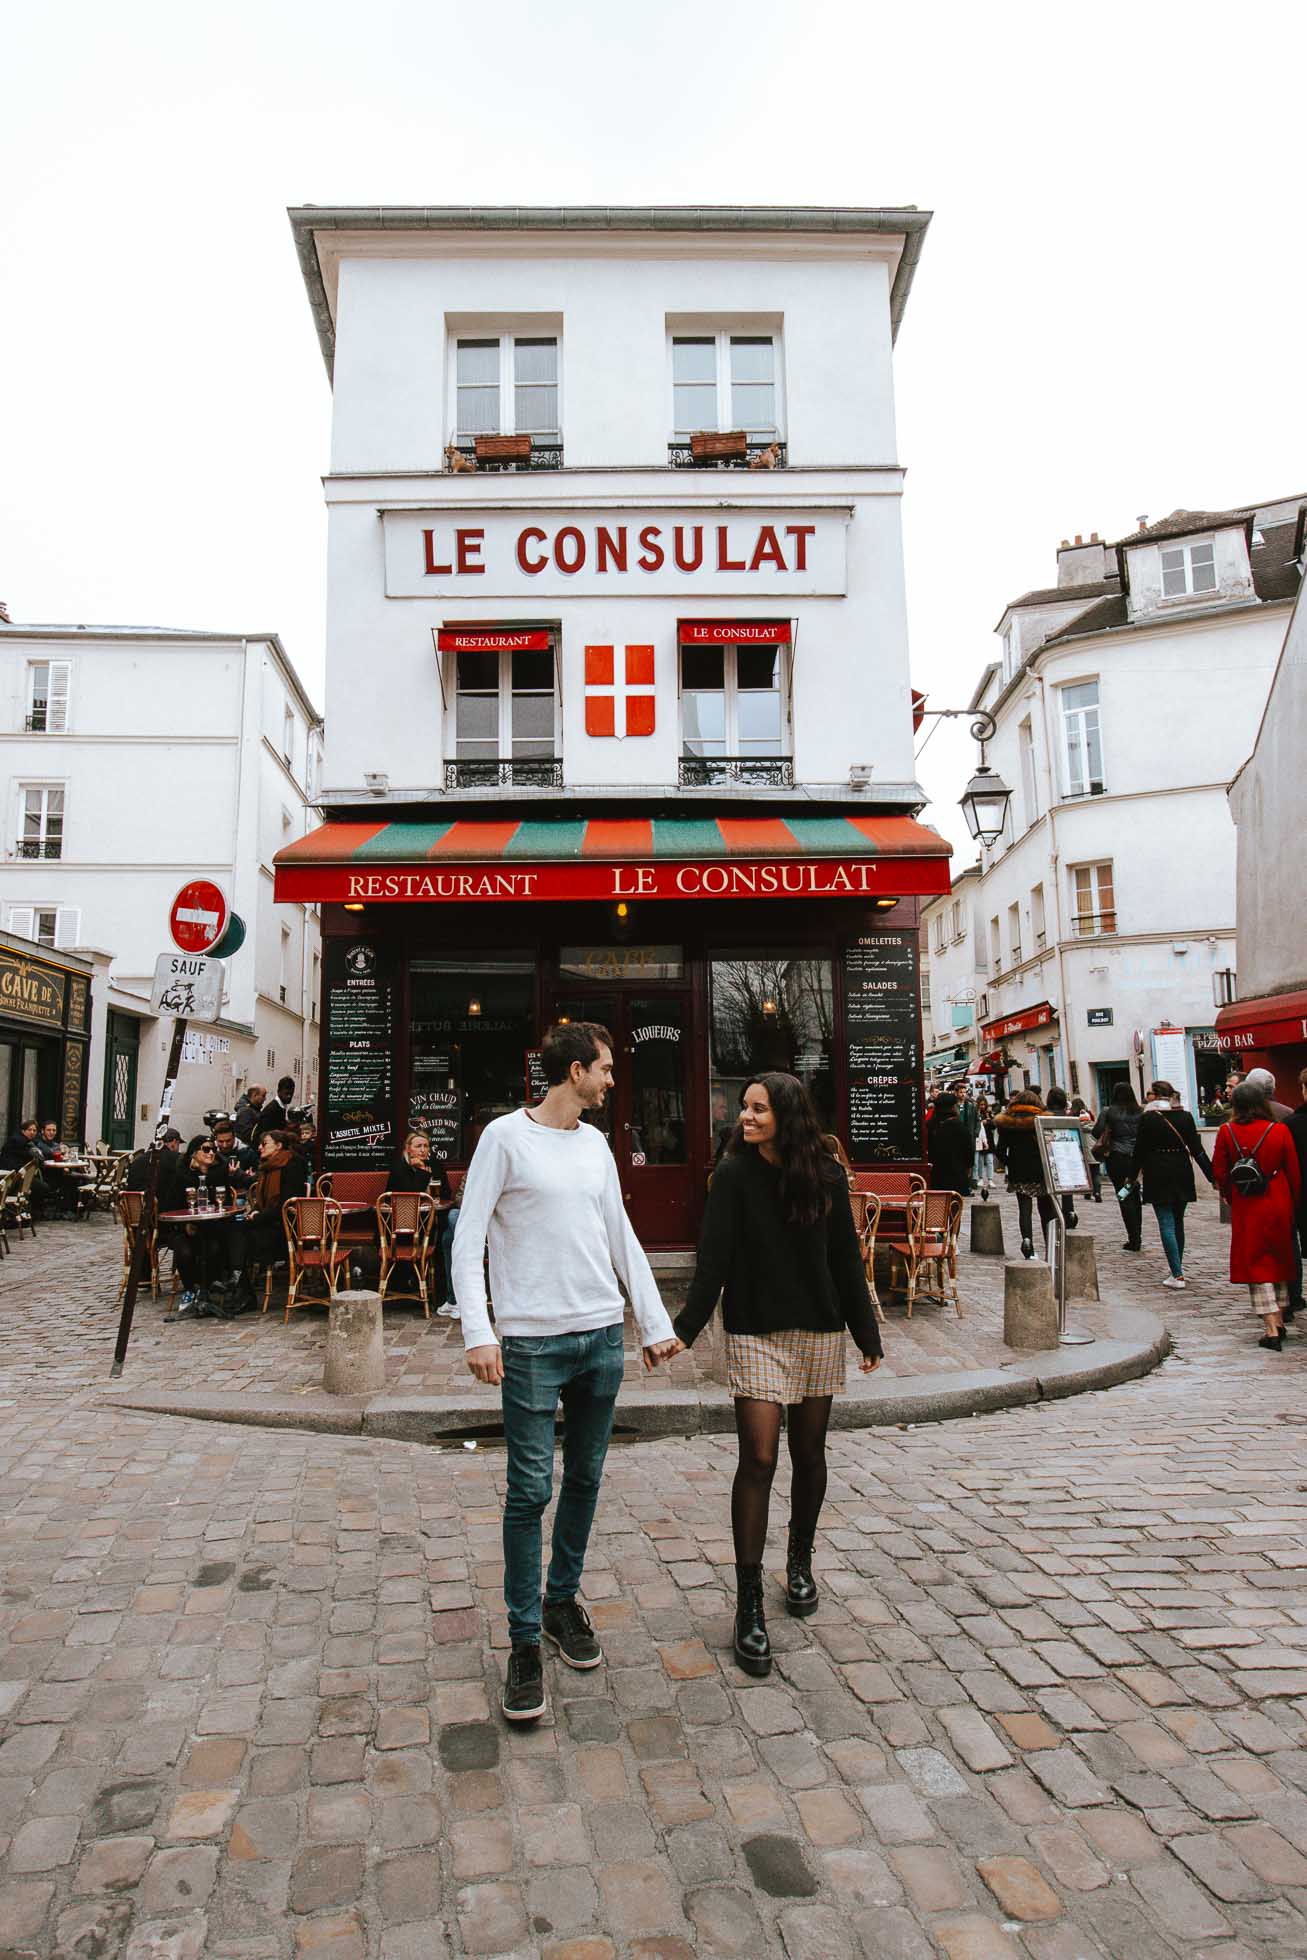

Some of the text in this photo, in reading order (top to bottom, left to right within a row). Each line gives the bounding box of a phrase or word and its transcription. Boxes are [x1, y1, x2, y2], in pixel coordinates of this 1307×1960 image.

[421, 525, 816, 575] LE CONSULAT
[693, 627, 778, 638] LE CONSULAT
[455, 635, 532, 647] RESTAURANT
[348, 874, 538, 896] RESTAURANT
[611, 864, 877, 894] LE CONSULAT
[858, 937, 902, 945] OMELETTES
[170, 959, 206, 976] SAUF
[2, 971, 38, 1002] CAVE
[41, 986, 52, 1002] DE
[862, 982, 897, 990] SALADES
[632, 1025, 681, 1043] LIQUEURS
[1234, 1033, 1255, 1047] BAR
[867, 1075, 898, 1084] CRÊPES
[410, 1093, 457, 1105] VIN CHAUD
[329, 1123, 386, 1140] L'ASSIETTE MIXTE
